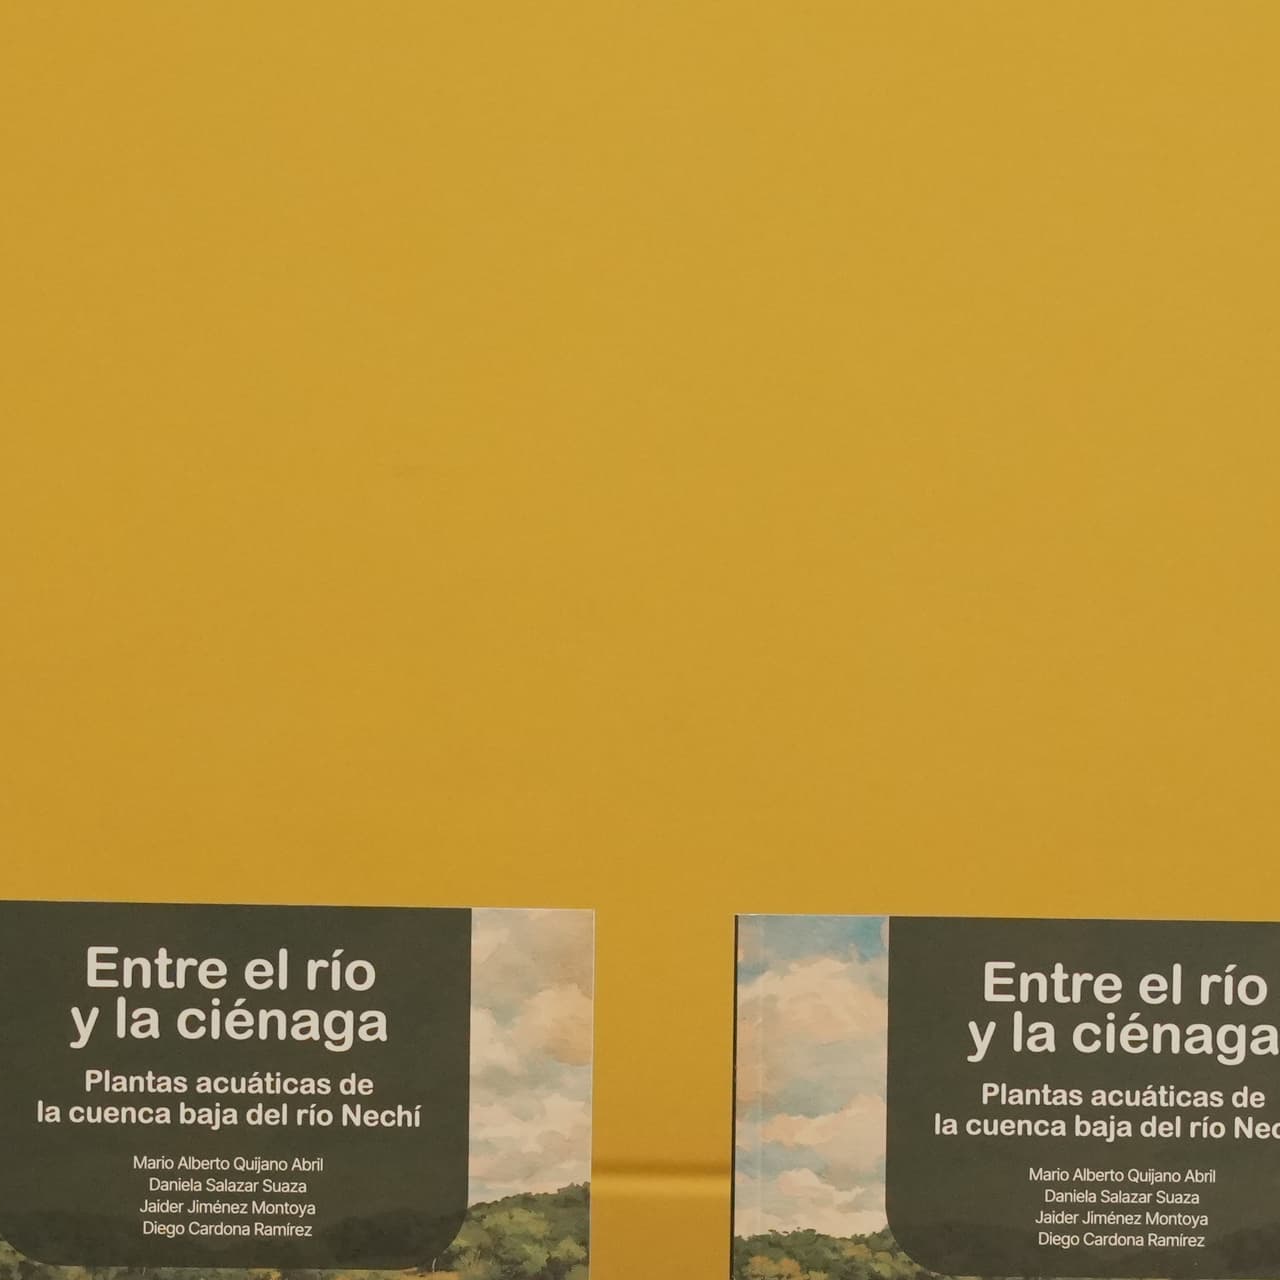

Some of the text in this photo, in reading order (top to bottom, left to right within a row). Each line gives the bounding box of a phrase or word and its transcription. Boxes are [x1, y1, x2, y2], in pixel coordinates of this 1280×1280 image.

[86, 946, 376, 992] Entre el río
[984, 961, 1268, 1006] Entre el río
[69, 995, 388, 1053] y la ciénaga
[966, 1010, 1280, 1066] y la ciénaga
[85, 1069, 374, 1096] Plantas acuáticas de
[982, 1082, 1266, 1109] Plantas acuáticas de
[37, 1099, 422, 1131] la cuenca baja del río Nechí
[934, 1112, 958, 1136] la
[965, 1118, 1067, 1137] cuenca
[1074, 1114, 1133, 1143] baja
[1140, 1115, 1182, 1138] del
[1189, 1115, 1226, 1139] río
[133, 1155, 324, 1174] Mario Alberto Quijano Abril
[149, 1177, 307, 1194] Daniela Salazar Suaza
[1029, 1167, 1216, 1186] Mario Alberto Quijano Abril
[139, 1198, 316, 1218] Jaider Jiménez Montoya
[1044, 1188, 1200, 1205] Daniela Salazar Suaza
[143, 1220, 313, 1239] Diego Cardona Ramírez
[1034, 1210, 1209, 1229] Jaider Jiménez Montoya
[1038, 1231, 1206, 1250] Diego Cardona Ramírez
